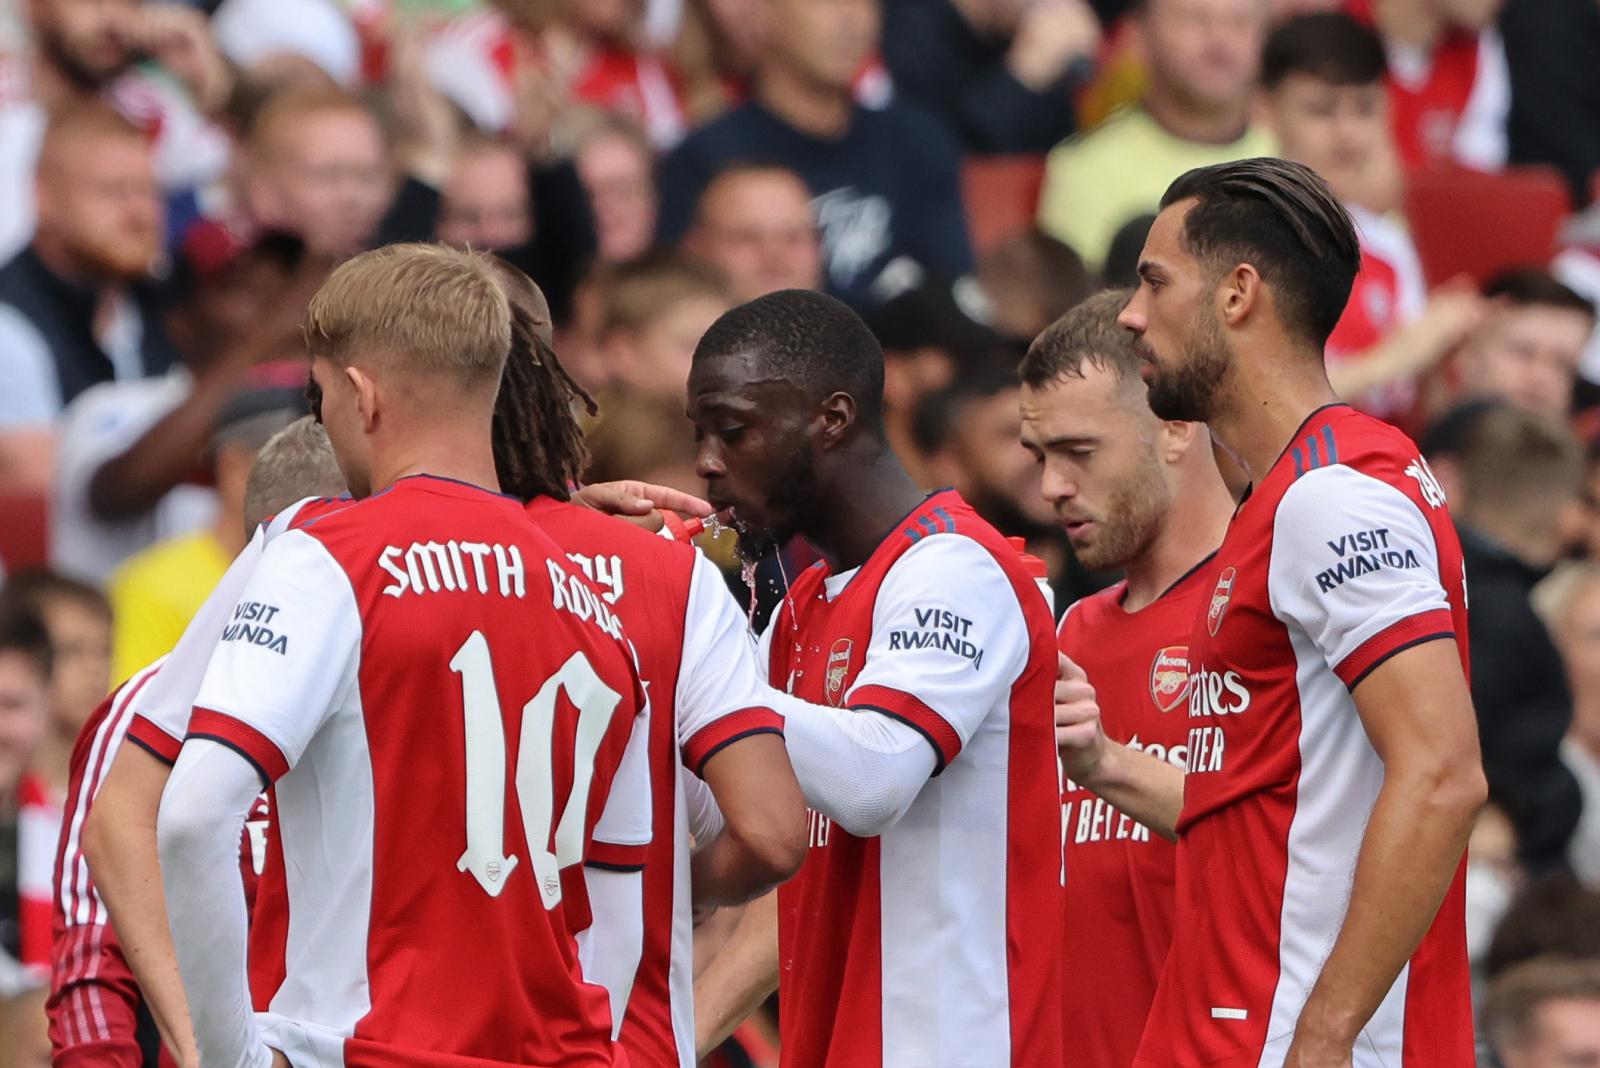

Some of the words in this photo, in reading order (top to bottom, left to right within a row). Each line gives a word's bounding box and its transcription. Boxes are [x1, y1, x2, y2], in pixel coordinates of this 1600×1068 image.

[1327, 528, 1389, 557] VISIT
[378, 540, 526, 599] SMITH
[1314, 549, 1421, 594] RWANDA
[233, 601, 280, 624] VISIT
[914, 608, 973, 637] VISIT
[888, 630, 984, 671] RWANDA
[449, 630, 622, 910] 10
